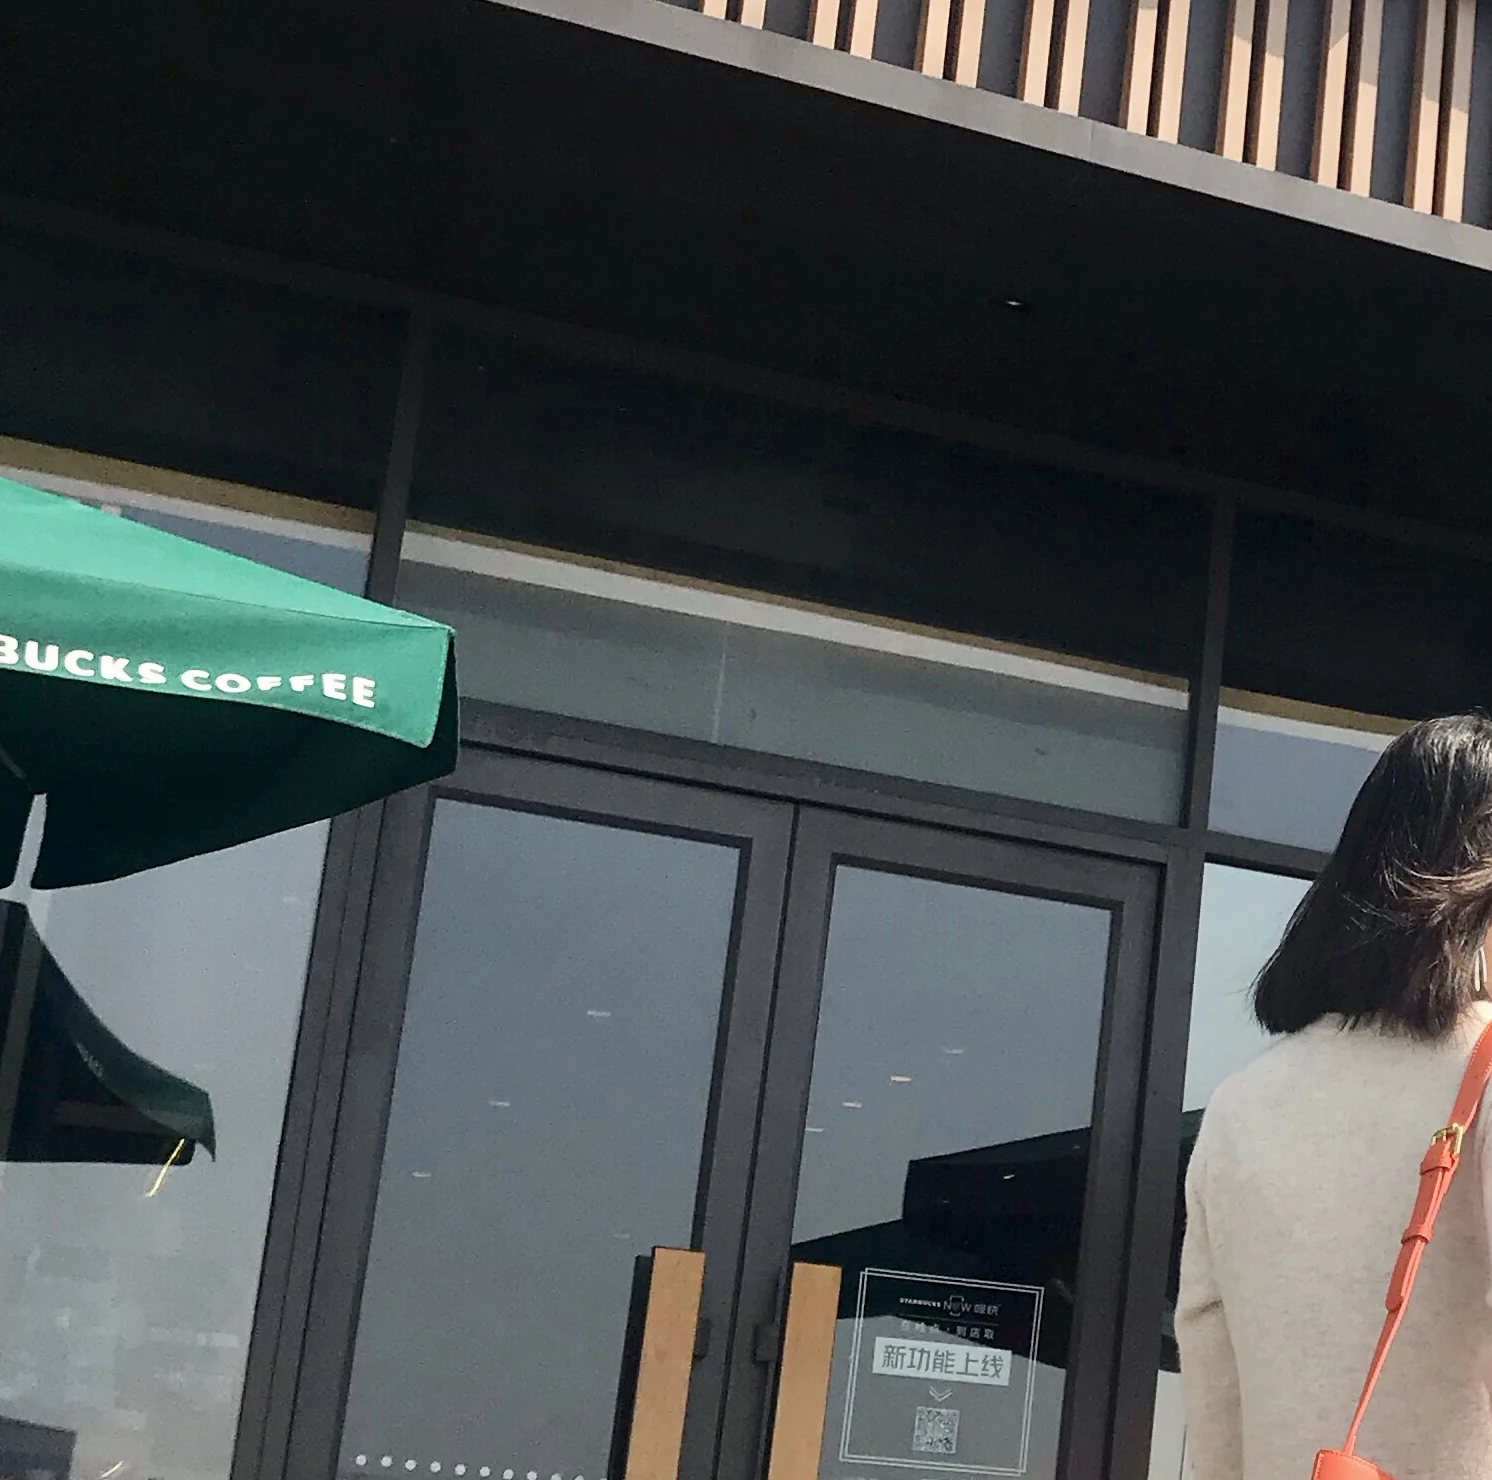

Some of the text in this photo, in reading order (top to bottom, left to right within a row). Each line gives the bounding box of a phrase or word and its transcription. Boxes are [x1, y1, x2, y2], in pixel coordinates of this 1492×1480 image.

[181, 669, 376, 709] COFFEE
[881, 1344, 1004, 1379] 新功能上线
